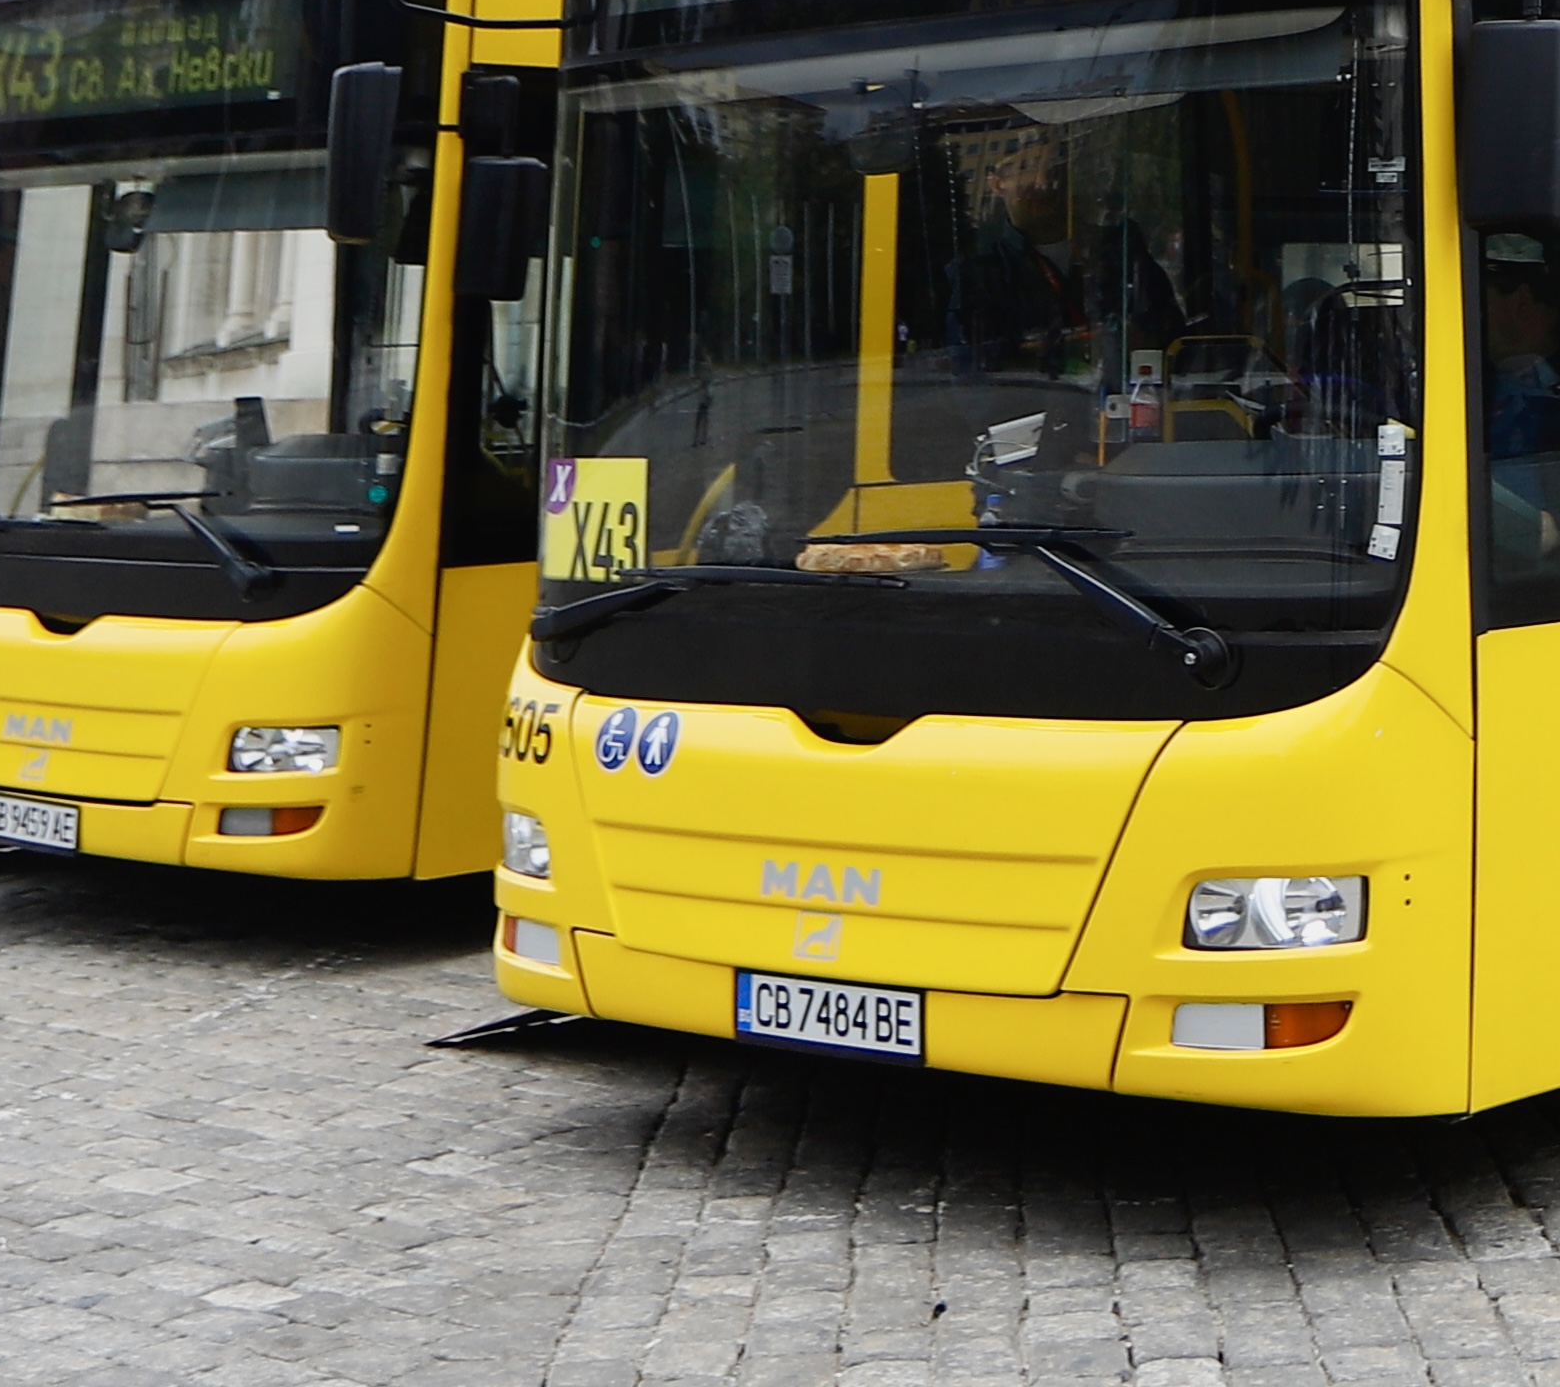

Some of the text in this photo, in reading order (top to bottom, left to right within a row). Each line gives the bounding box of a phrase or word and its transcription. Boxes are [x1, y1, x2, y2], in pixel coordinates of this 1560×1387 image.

[549, 464, 573, 503] X
[569, 500, 639, 581] X43
[4, 713, 74, 744] MAN
[761, 858, 882, 907] MAN
